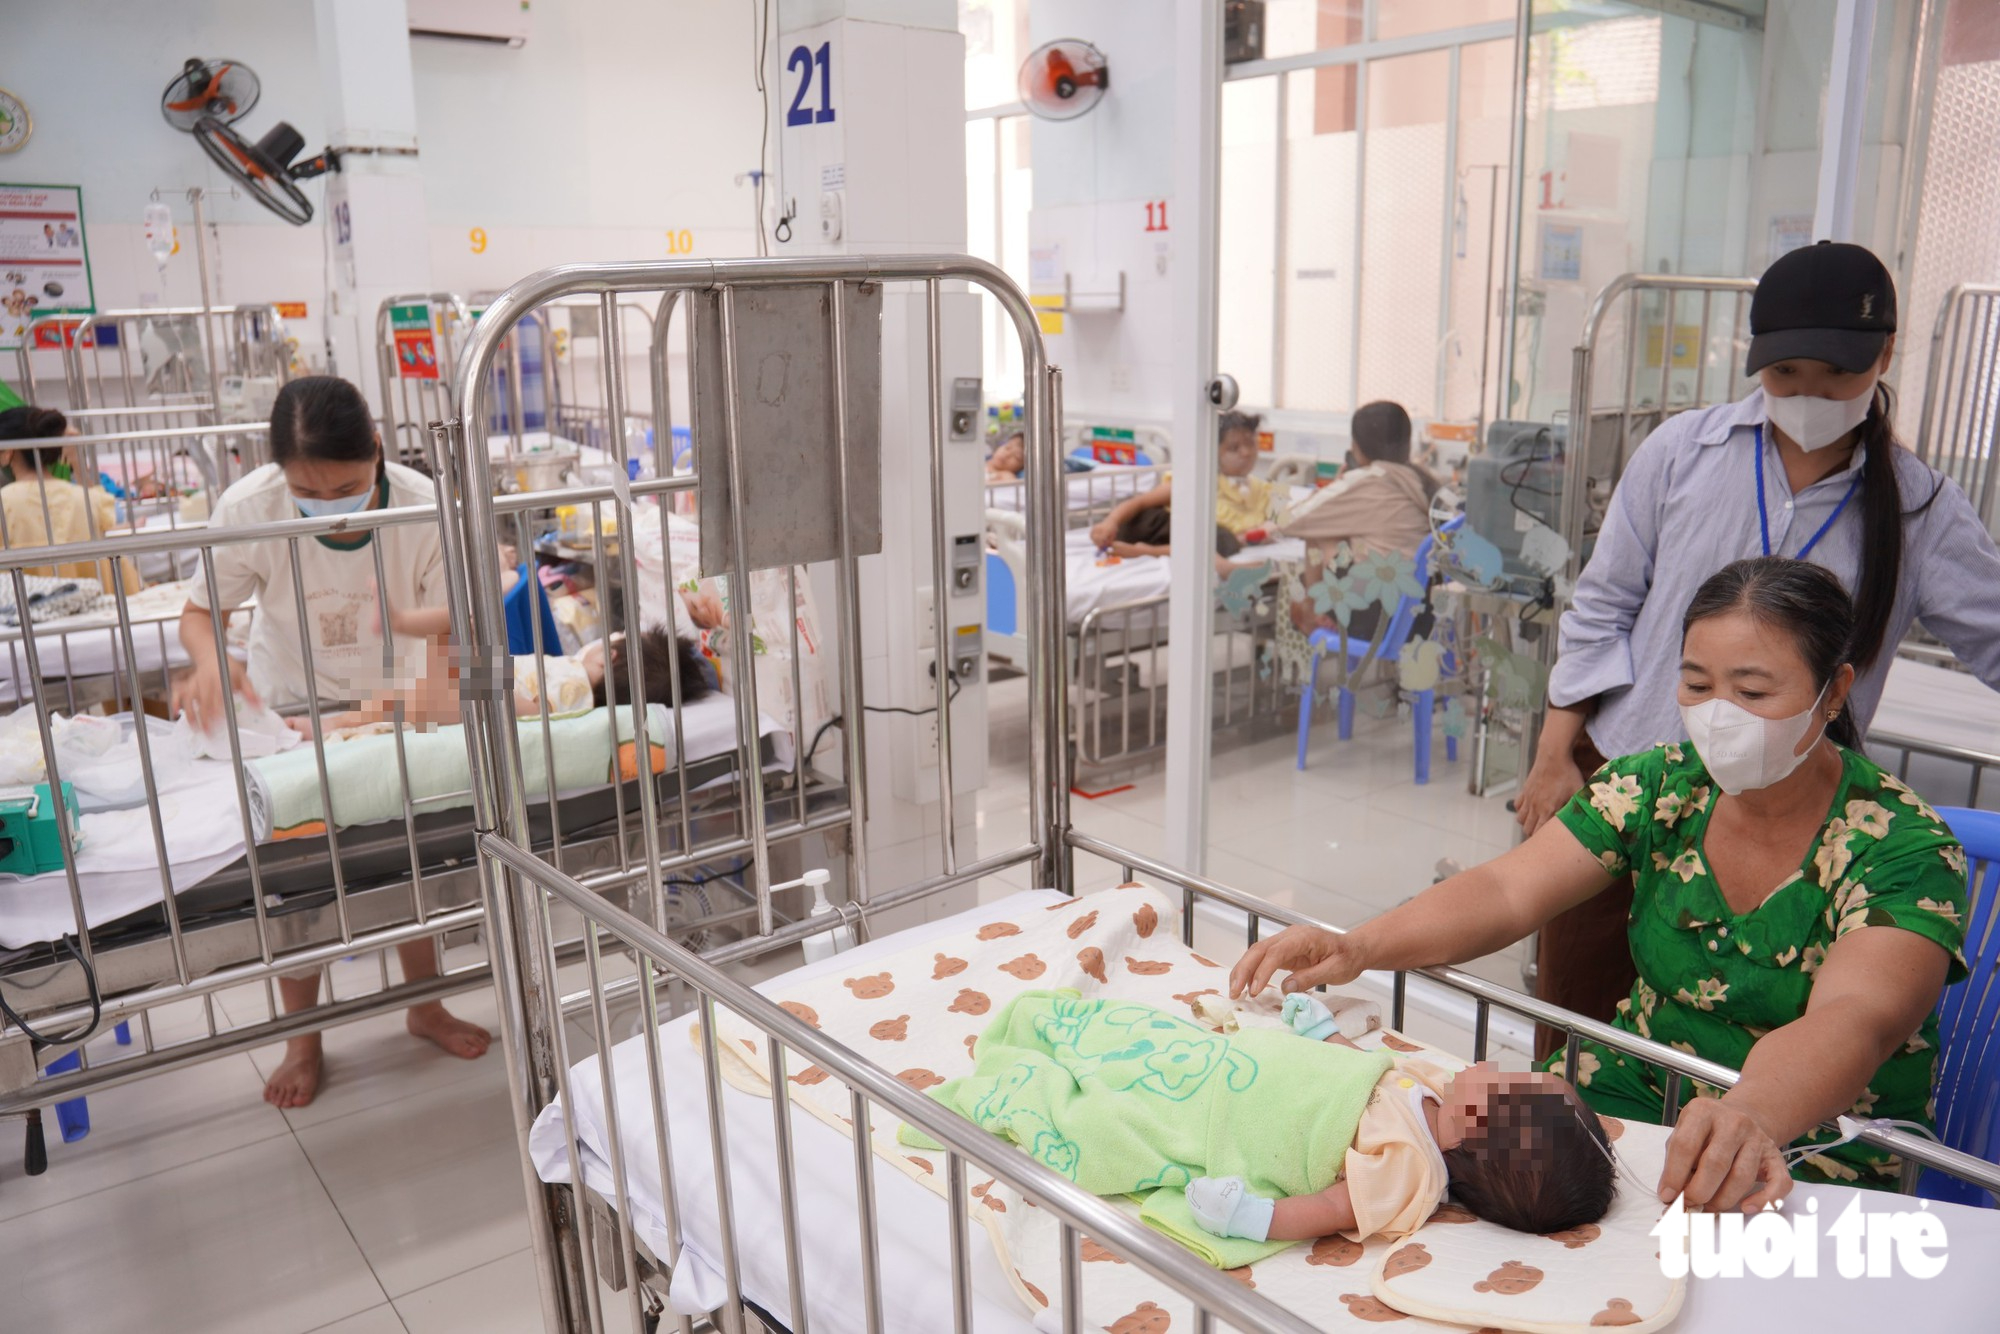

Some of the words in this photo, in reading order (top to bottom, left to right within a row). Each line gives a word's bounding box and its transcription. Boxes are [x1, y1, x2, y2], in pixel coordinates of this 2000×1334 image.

[786, 41, 836, 127] 21
[1537, 171, 1567, 210] 1
[334, 201, 352, 245] 19
[1144, 201, 1169, 232] 11
[469, 226, 487, 254] 9
[666, 229, 693, 254] 10
